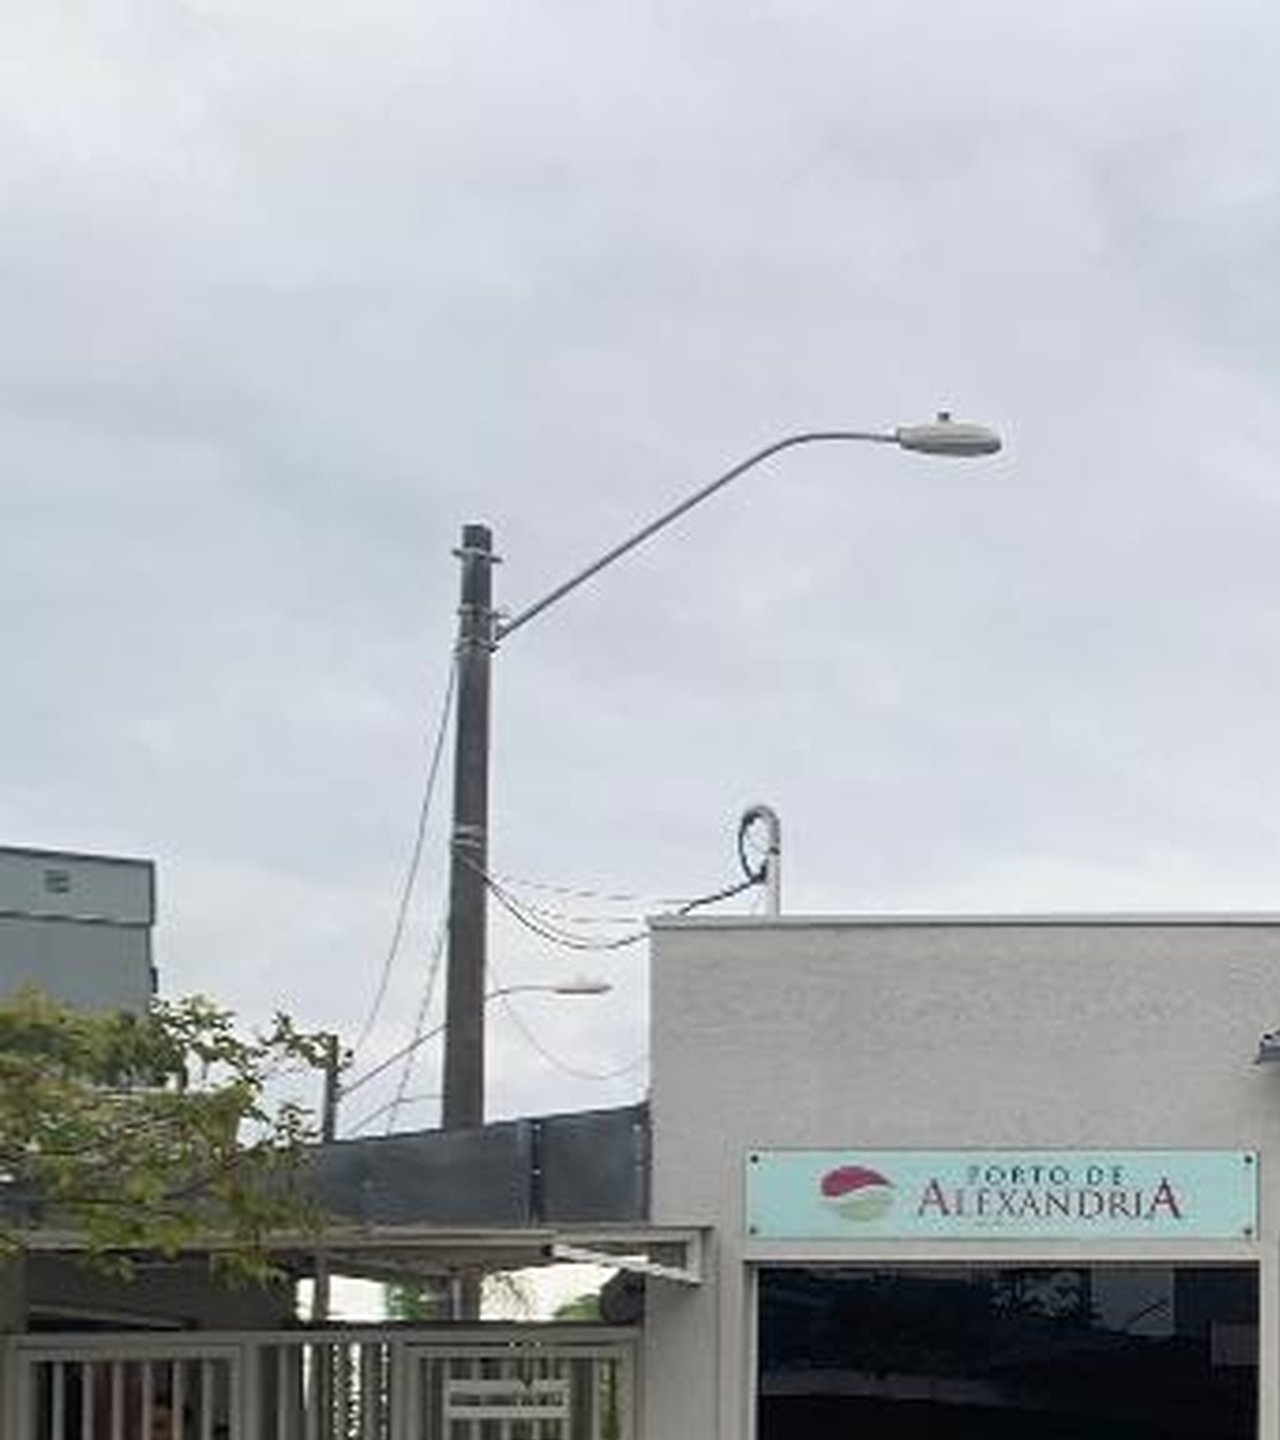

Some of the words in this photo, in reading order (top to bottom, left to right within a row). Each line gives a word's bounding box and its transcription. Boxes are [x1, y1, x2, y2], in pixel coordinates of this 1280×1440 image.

[967, 1164, 1071, 1187] PORTO
[1086, 1164, 1125, 1186] DE
[916, 1176, 1184, 1221] ALEXANDRIA
